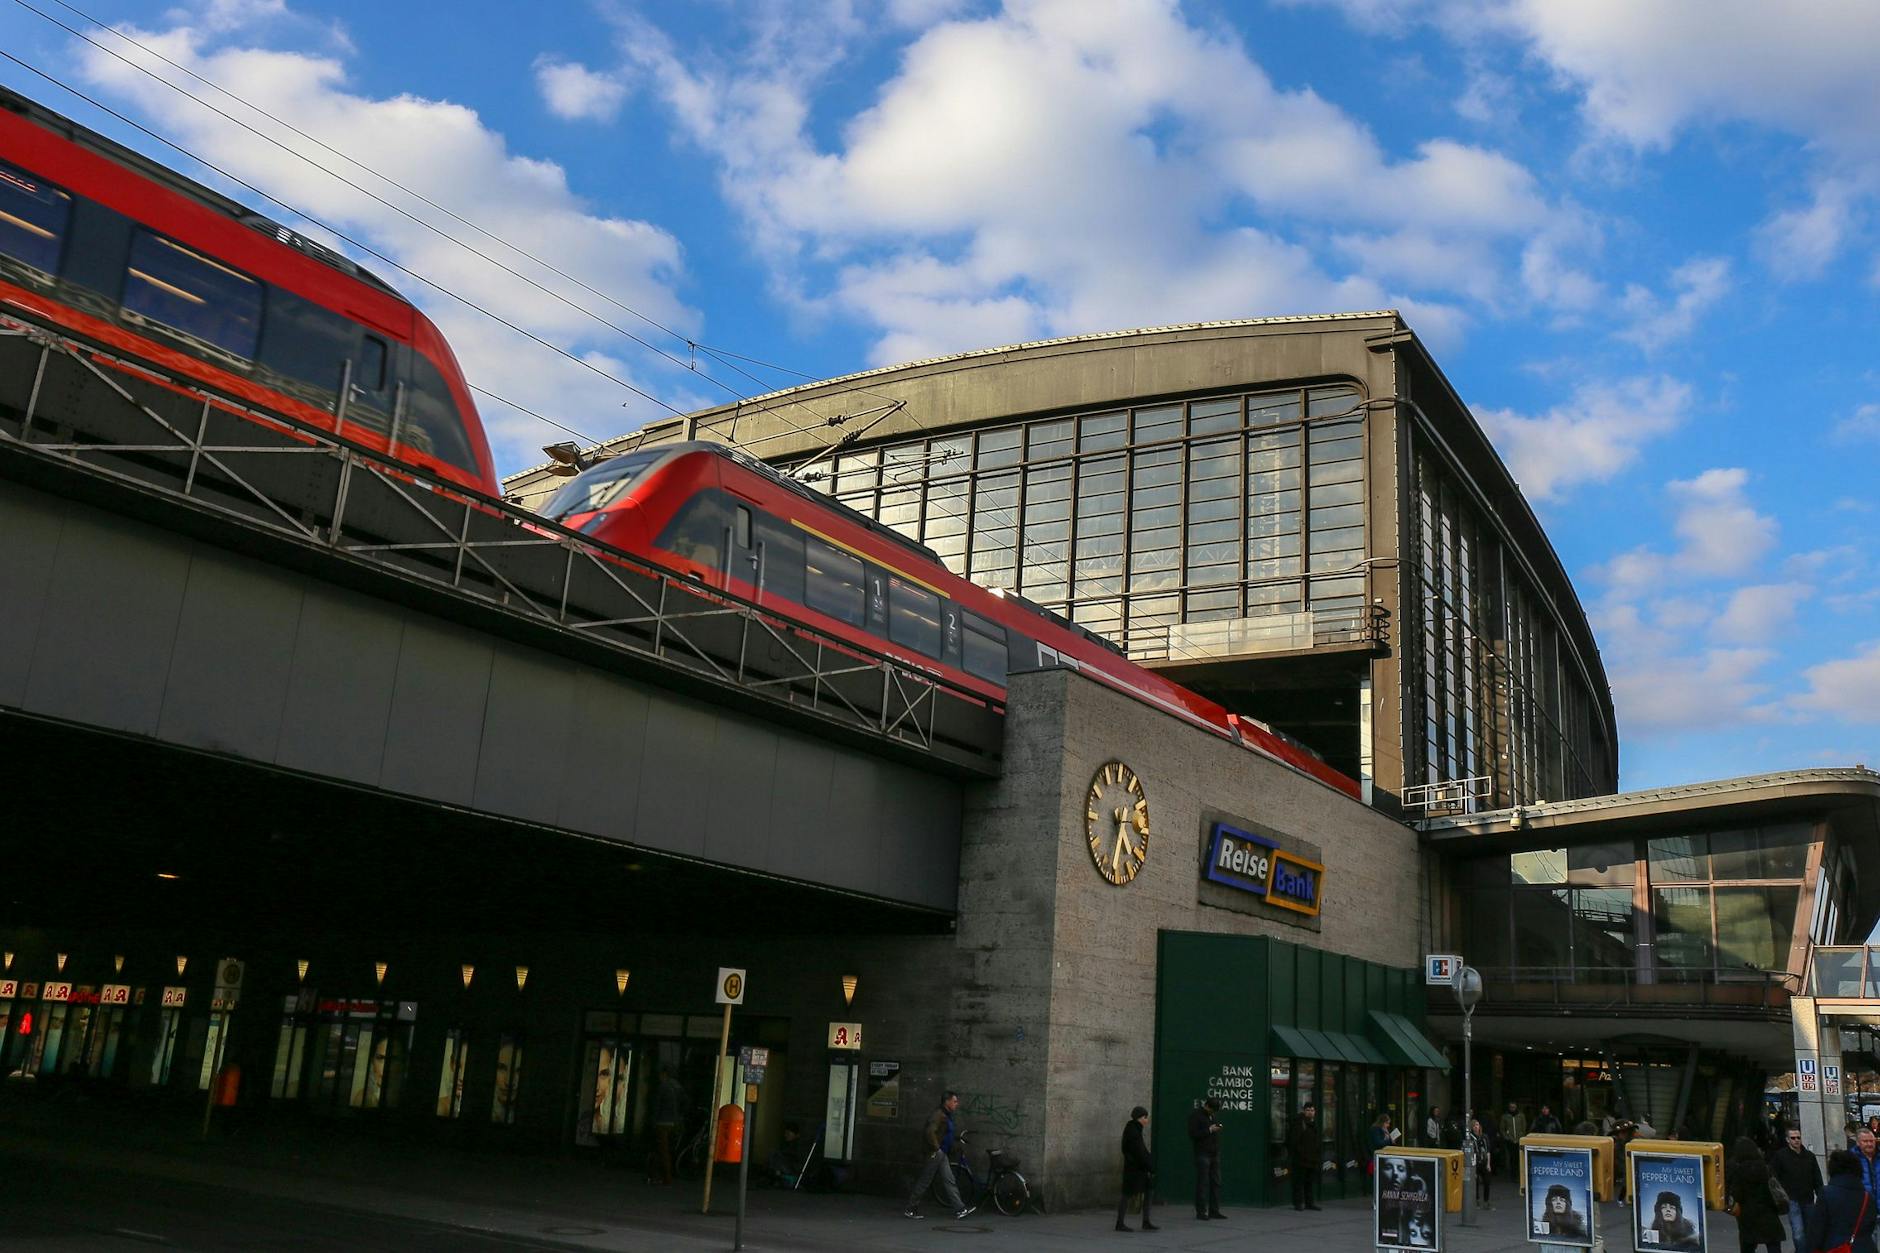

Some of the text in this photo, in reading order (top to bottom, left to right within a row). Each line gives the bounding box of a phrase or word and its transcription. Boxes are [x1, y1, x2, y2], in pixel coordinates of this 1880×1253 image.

[874, 579, 881, 596] 1
[948, 613, 957, 630] 2
[1219, 838, 1268, 880] Reise
[1275, 861, 1314, 900] Bank
[1222, 1065, 1253, 1077] BANK
[1801, 1060, 1814, 1073] U
[1208, 1077, 1253, 1088] CAMBIO
[1207, 1088, 1253, 1099] CHANGE
[1193, 1099, 1253, 1111] EXANGE
[1553, 1160, 1583, 1169] MY SWEET
[1533, 1166, 1584, 1178] PEPPER LAND
[1674, 1167, 1694, 1175] SWEET
[1641, 1172, 1695, 1184] PEPPER LAND
